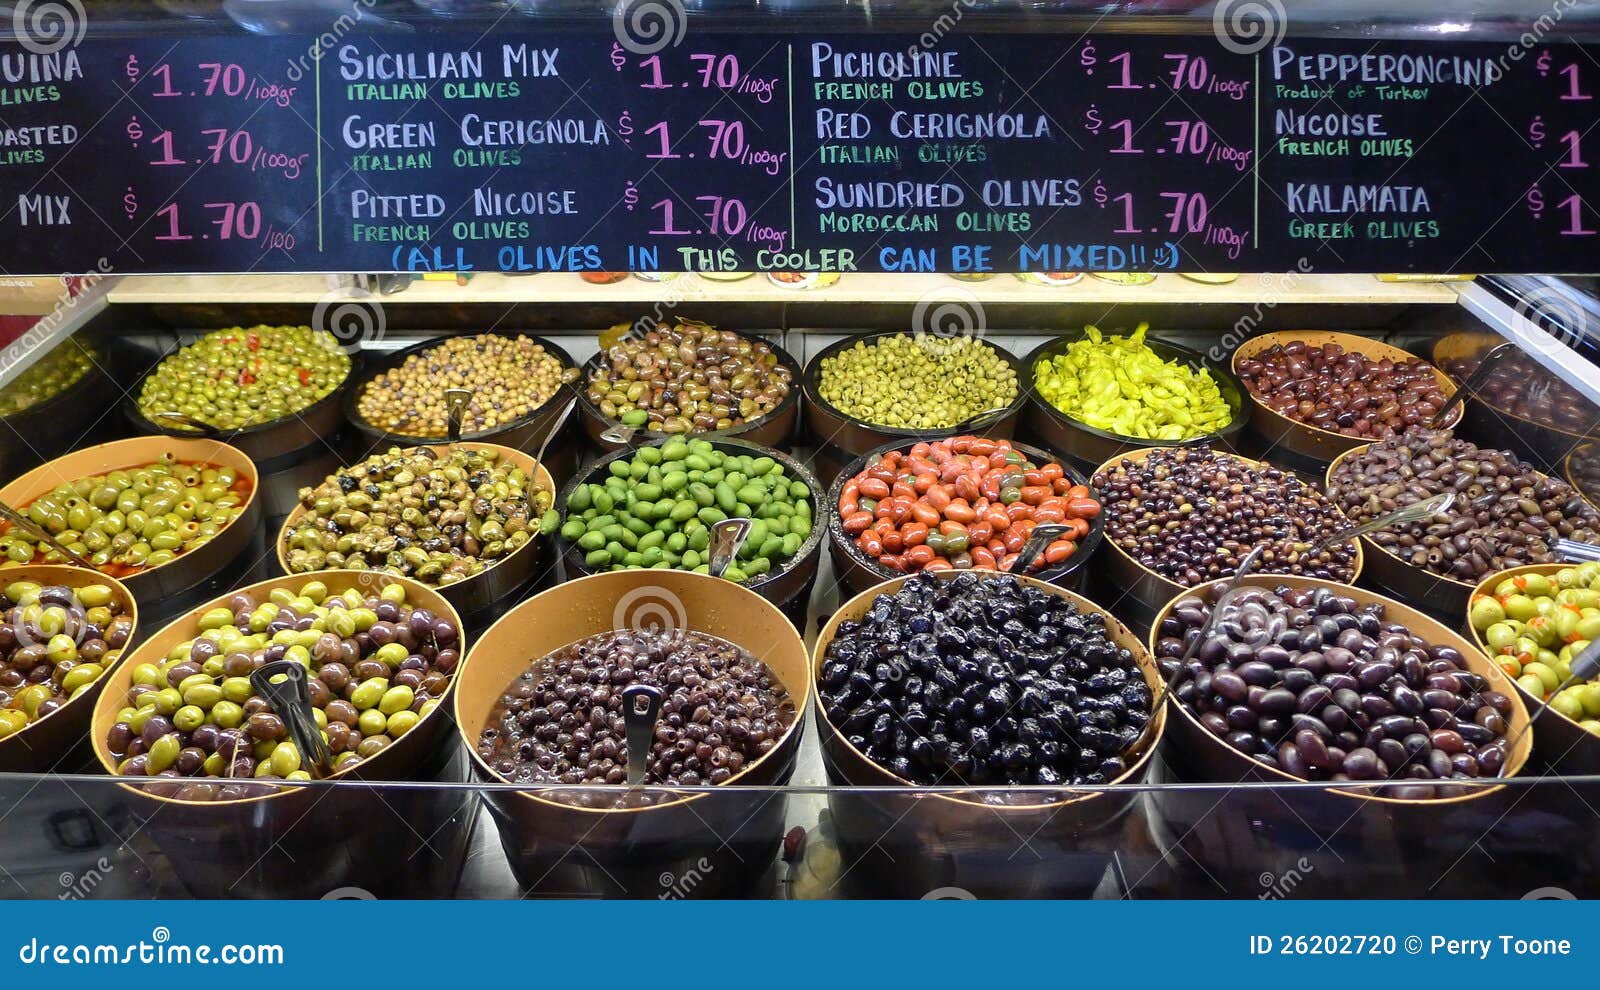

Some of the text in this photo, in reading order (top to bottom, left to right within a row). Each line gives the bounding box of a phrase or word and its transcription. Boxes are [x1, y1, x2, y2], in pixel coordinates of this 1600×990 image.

[339, 43, 559, 80] SICILIAN MIX
[811, 42, 962, 78] PICHOLINE
[348, 82, 520, 100] ITALIAN OLIVES
[815, 81, 984, 100] FRENCH OLIVES
[1276, 86, 1430, 101] Product of Turkey
[343, 114, 610, 149] GREEN CERIGNOLA
[816, 108, 1051, 139] RED CERIGNOLA
[1275, 109, 1387, 136] NICOISE
[0, 124, 78, 146] ASTED
[820, 144, 987, 164] ITALIAN OLIVES
[1279, 138, 1413, 157] FRENCH OLIVES
[353, 149, 522, 171] ITALIAN OLIVES
[352, 188, 578, 218] PITTED NICOISE
[815, 177, 1082, 208] SUNDRIED OLIVES
[1287, 183, 1431, 214] KALAMATA
[19, 194, 71, 226] MIX
[354, 221, 529, 242] FRENCH OLIVES
[820, 212, 1031, 233] MOROCCAN OLIVES
[1289, 221, 1440, 239] GREEK OLIVES
[498, 244, 602, 271] OLIVES
[628, 245, 659, 271] IN
[677, 247, 738, 271] THIS
[757, 248, 857, 271] COOLER
[880, 247, 936, 272] CAN
[953, 245, 993, 272] BE
